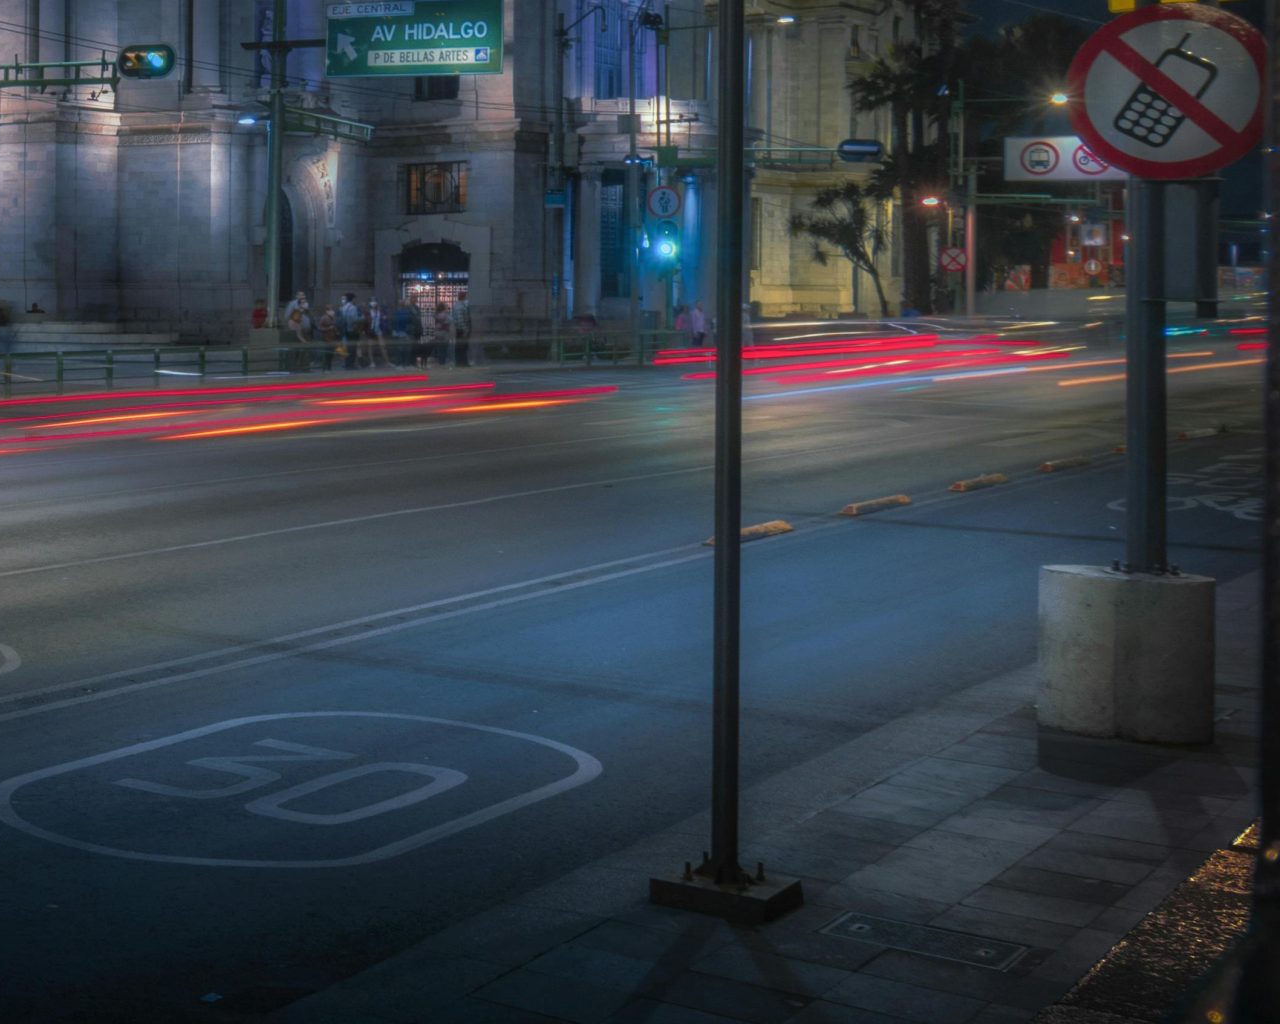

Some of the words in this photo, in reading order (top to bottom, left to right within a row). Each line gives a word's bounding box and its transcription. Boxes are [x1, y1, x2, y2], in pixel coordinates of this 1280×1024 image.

[332, 6, 351, 15] EJE
[357, 3, 407, 14] CENTRAL
[370, 24, 396, 43] AV
[404, 20, 488, 41] HIDALGO
[374, 53, 380, 64] P
[383, 52, 395, 63] DE
[400, 50, 436, 63] BELLAS
[439, 49, 469, 62] ARTES
